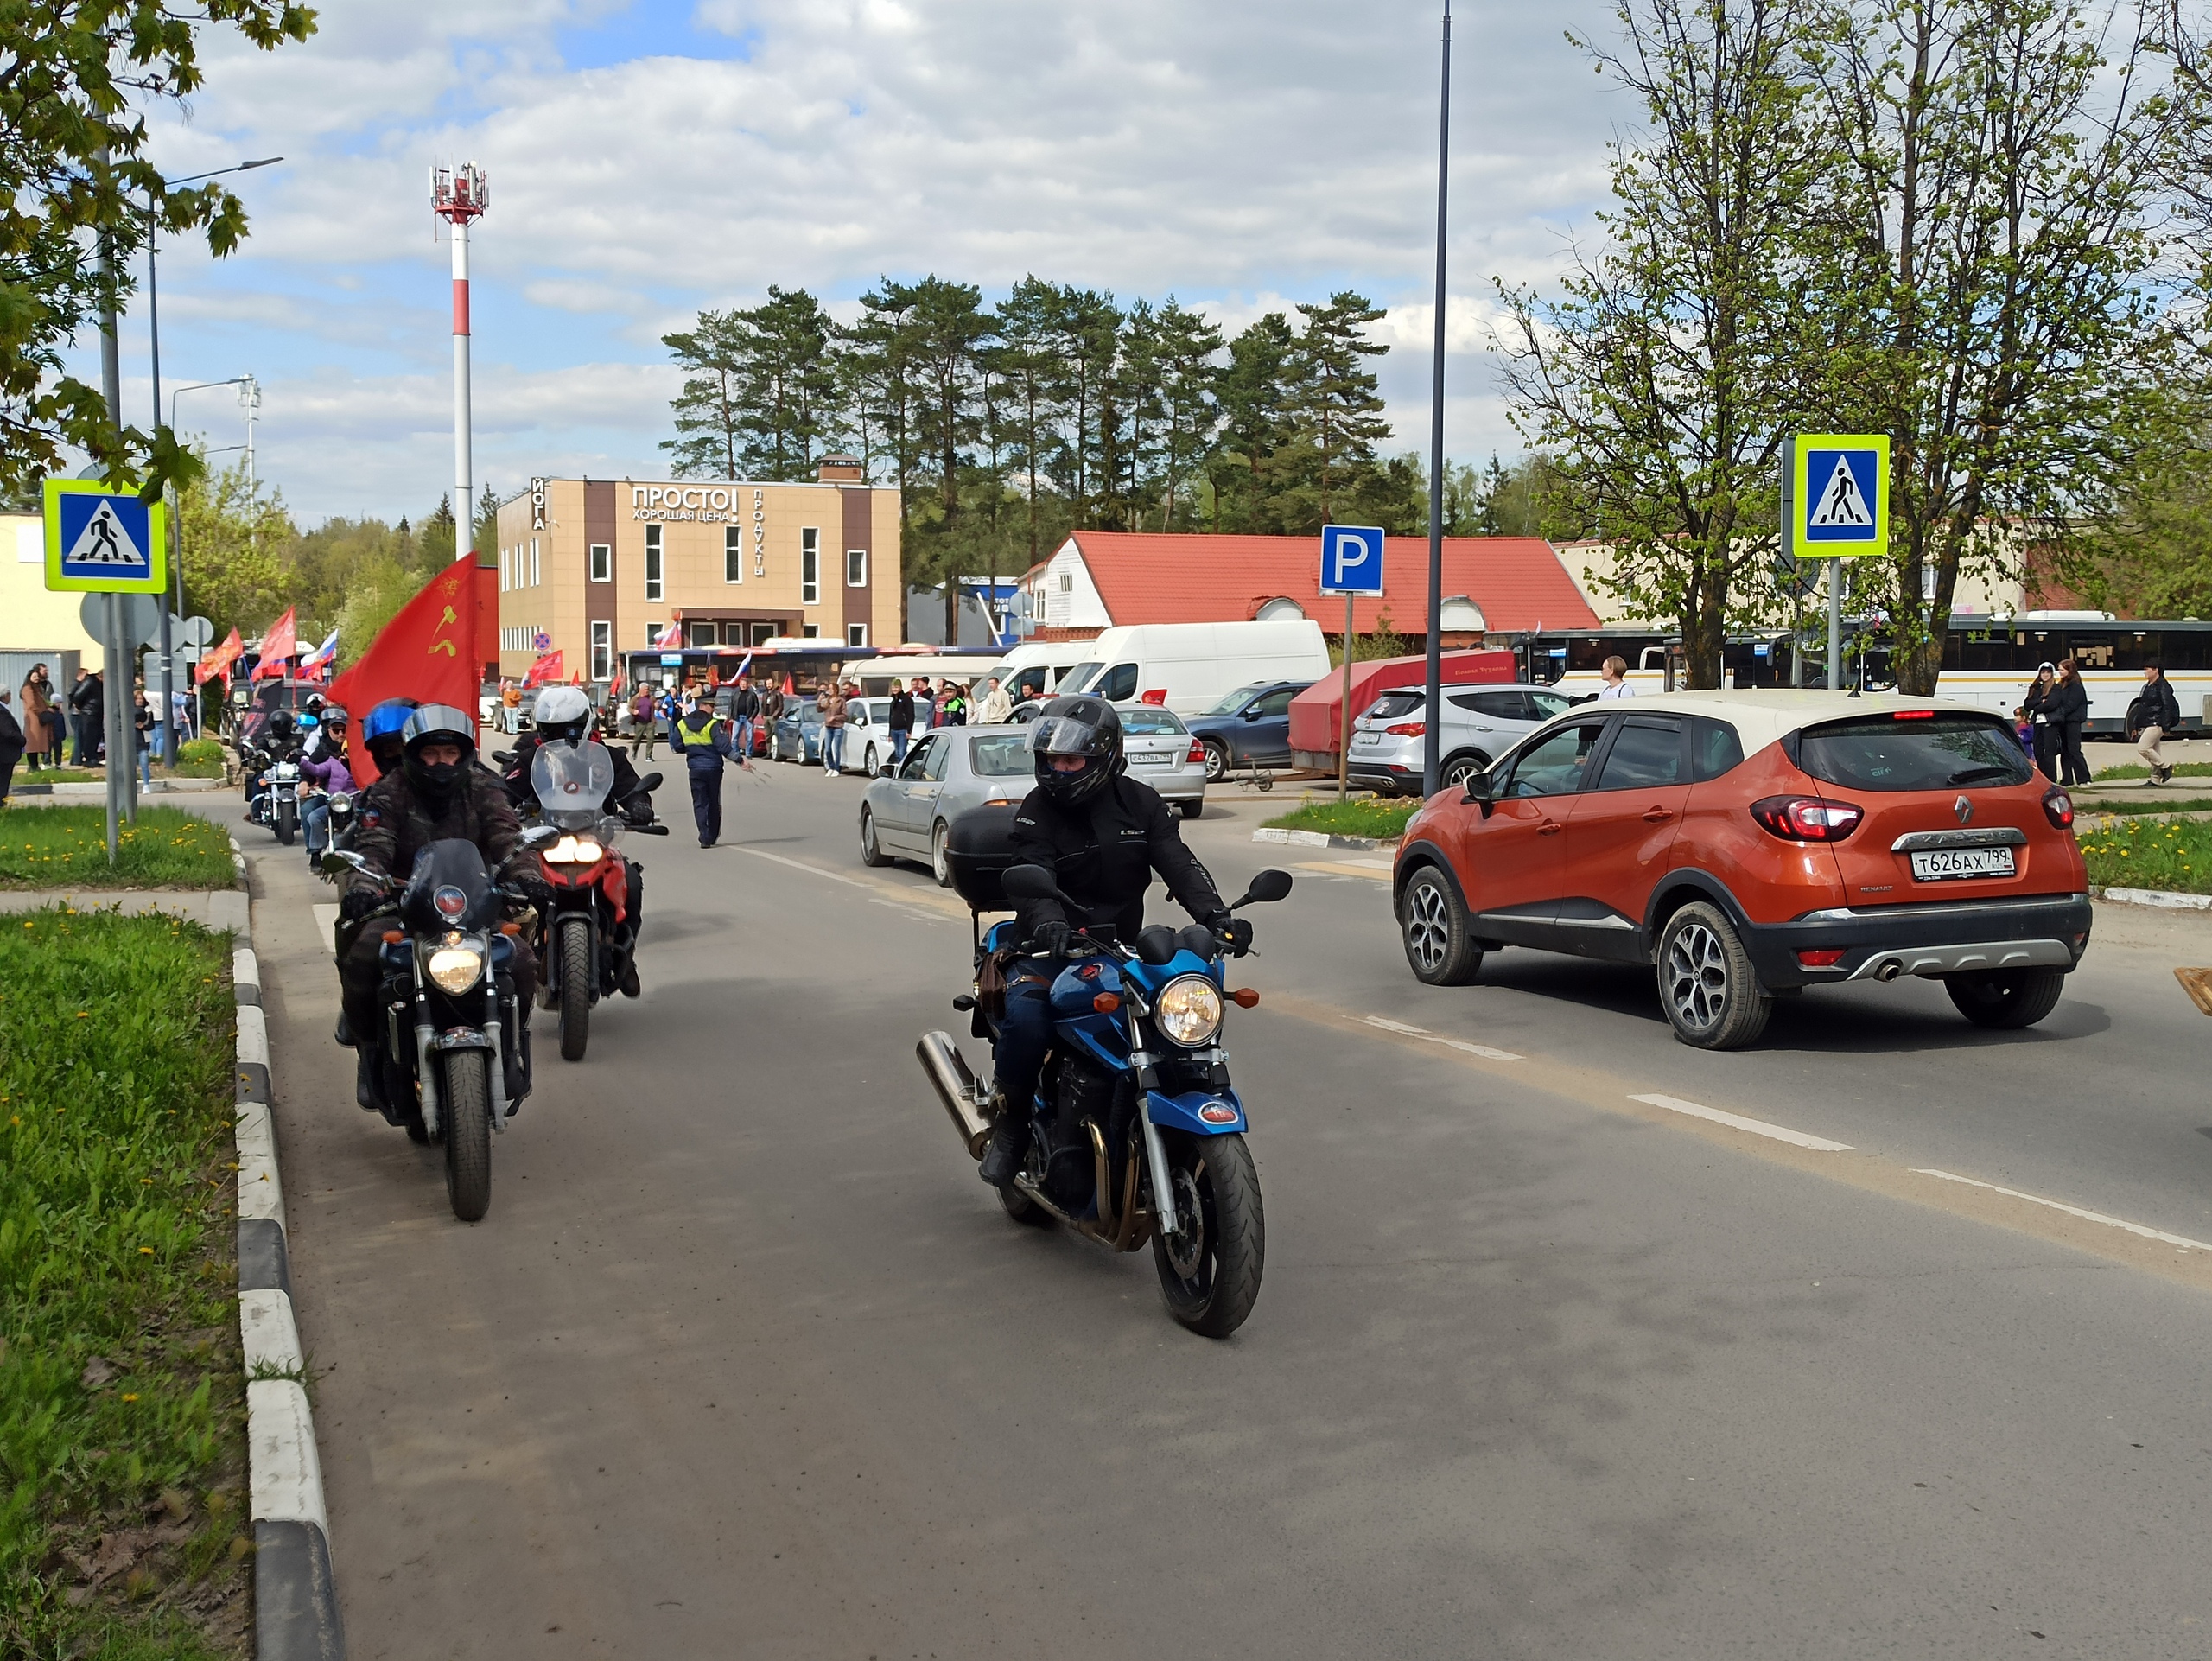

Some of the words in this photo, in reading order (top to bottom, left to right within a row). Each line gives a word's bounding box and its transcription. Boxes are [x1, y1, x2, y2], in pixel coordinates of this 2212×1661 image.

[532, 477, 545, 531] ЙОГА
[632, 509, 695, 520] ХОРОШАЯ
[698, 510, 730, 522] ЦЕНА
[753, 489, 764, 576] ПРОДУКТЫ
[1334, 534, 1369, 583] P
[1984, 850, 2007, 863] 799
